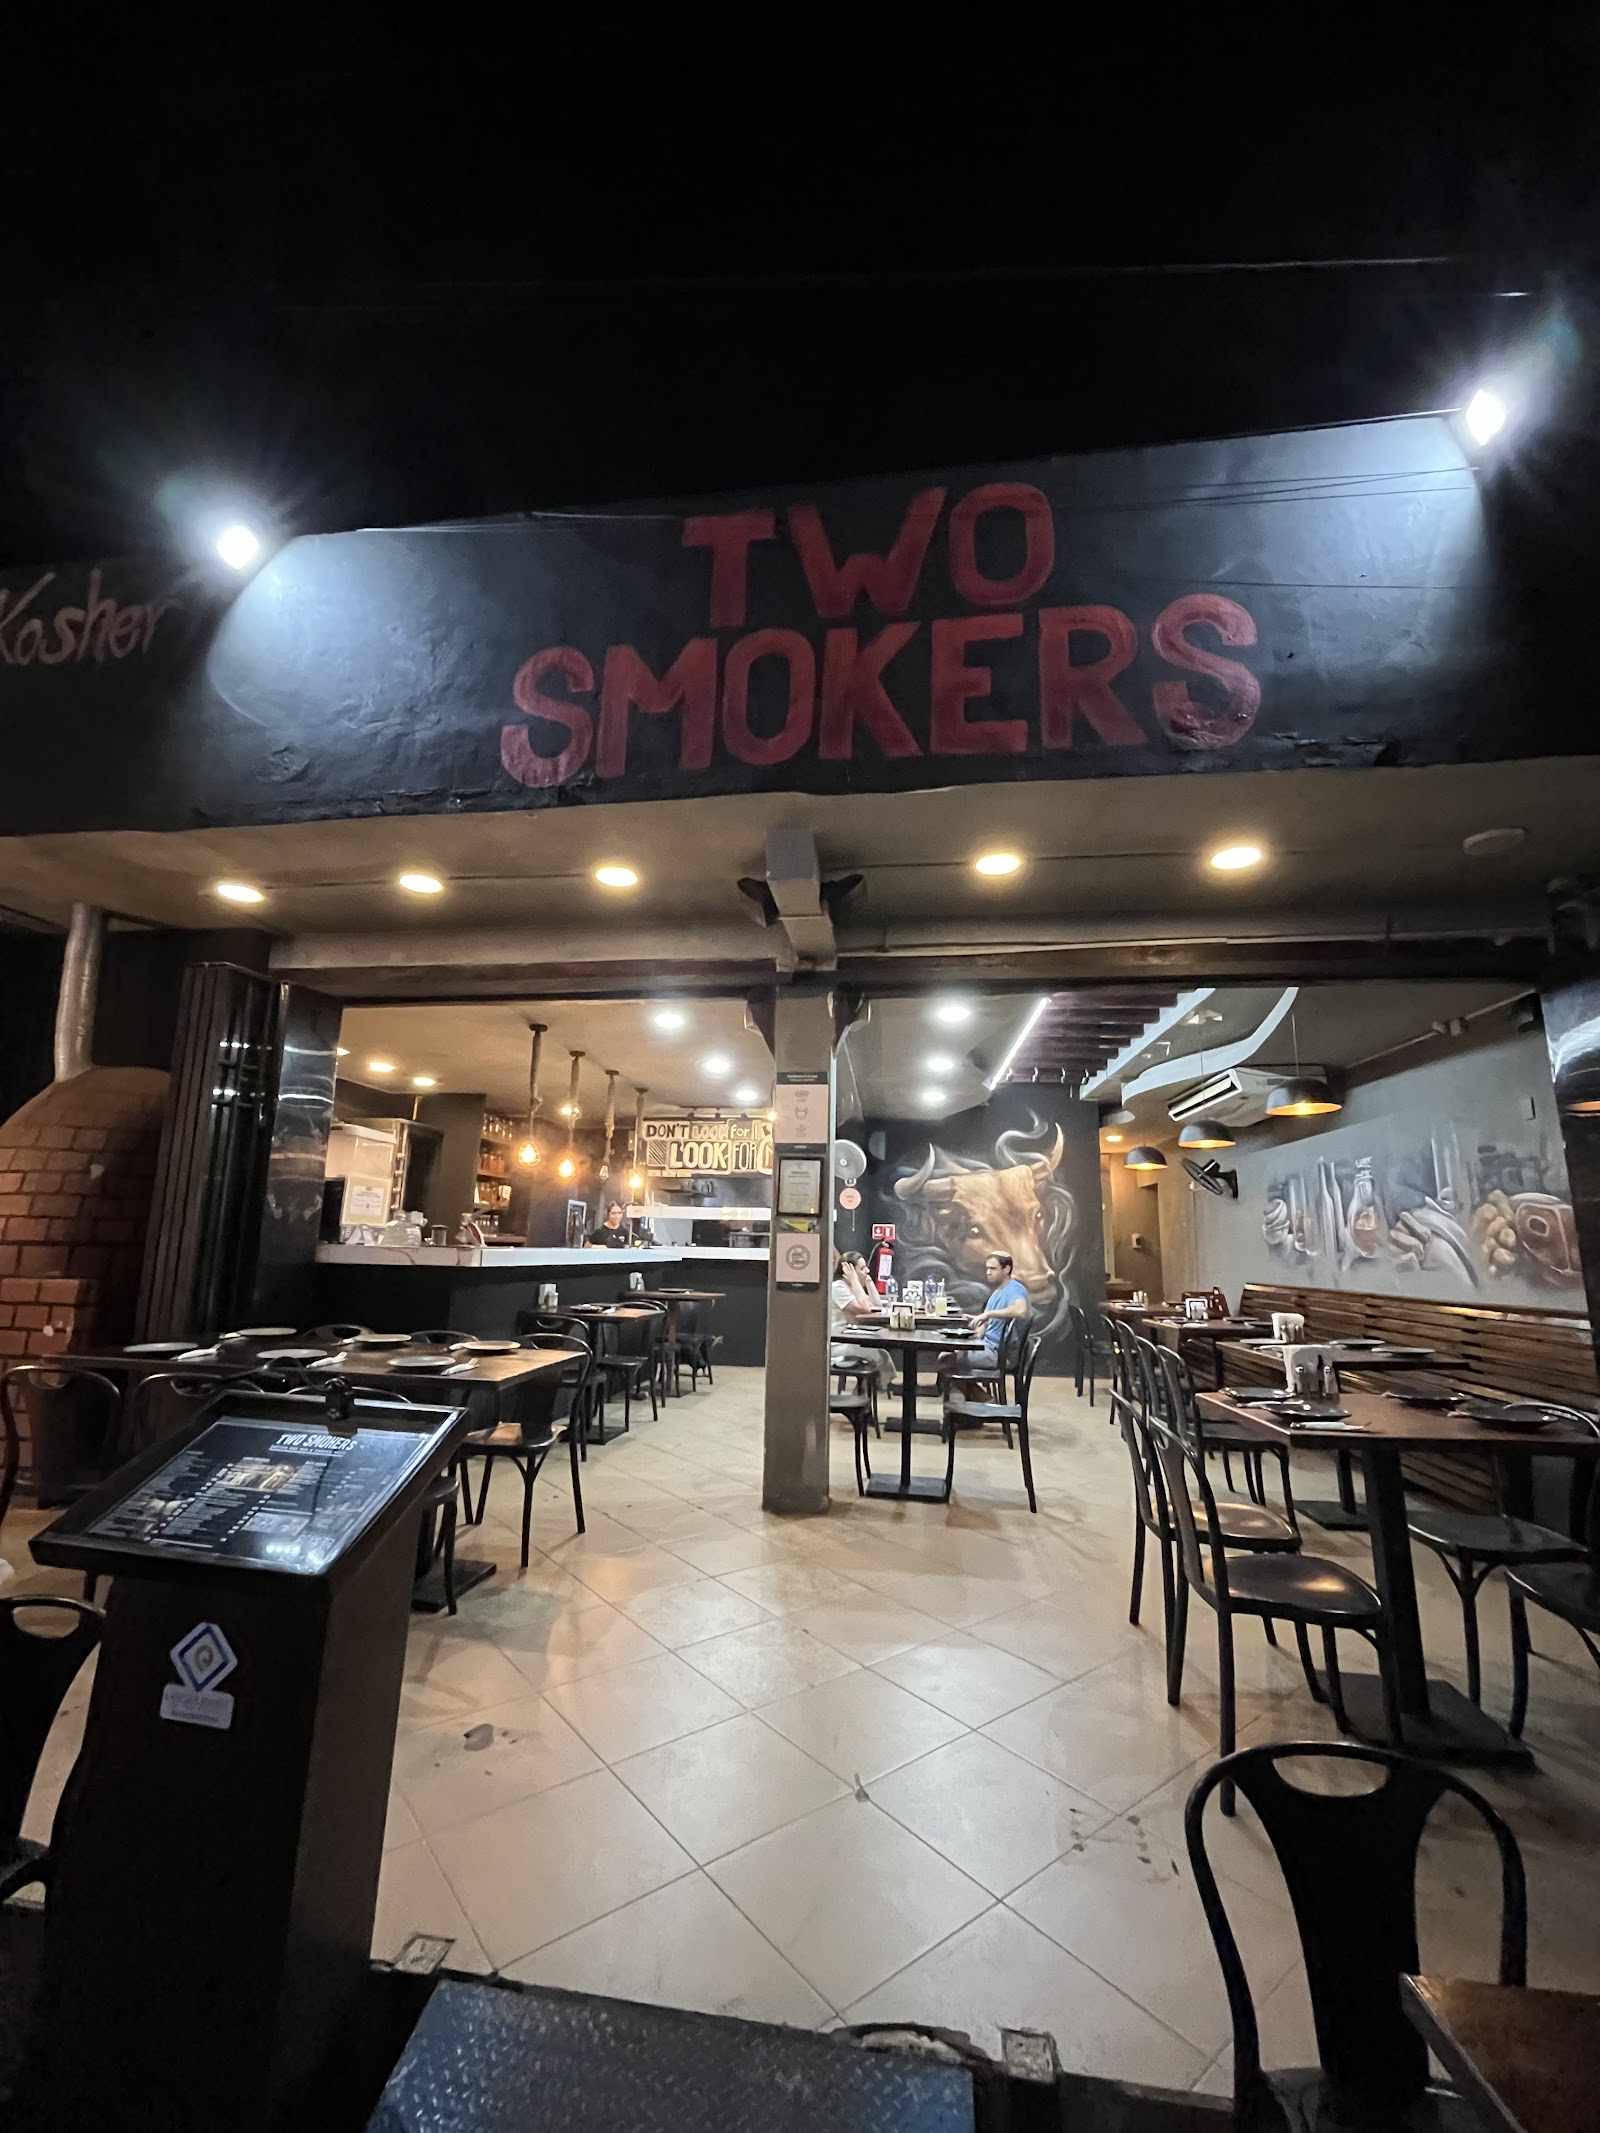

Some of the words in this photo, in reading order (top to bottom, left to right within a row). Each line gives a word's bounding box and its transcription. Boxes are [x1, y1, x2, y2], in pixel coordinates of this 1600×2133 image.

[683, 482, 1056, 629] TWO
[501, 593, 1262, 789] SMOKERS
[646, 1123, 689, 1138] DON'T
[730, 1124, 750, 1139] for
[670, 1141, 728, 1169] LOOK
[732, 1142, 758, 1170] FOR
[276, 1434, 307, 1446] TWO
